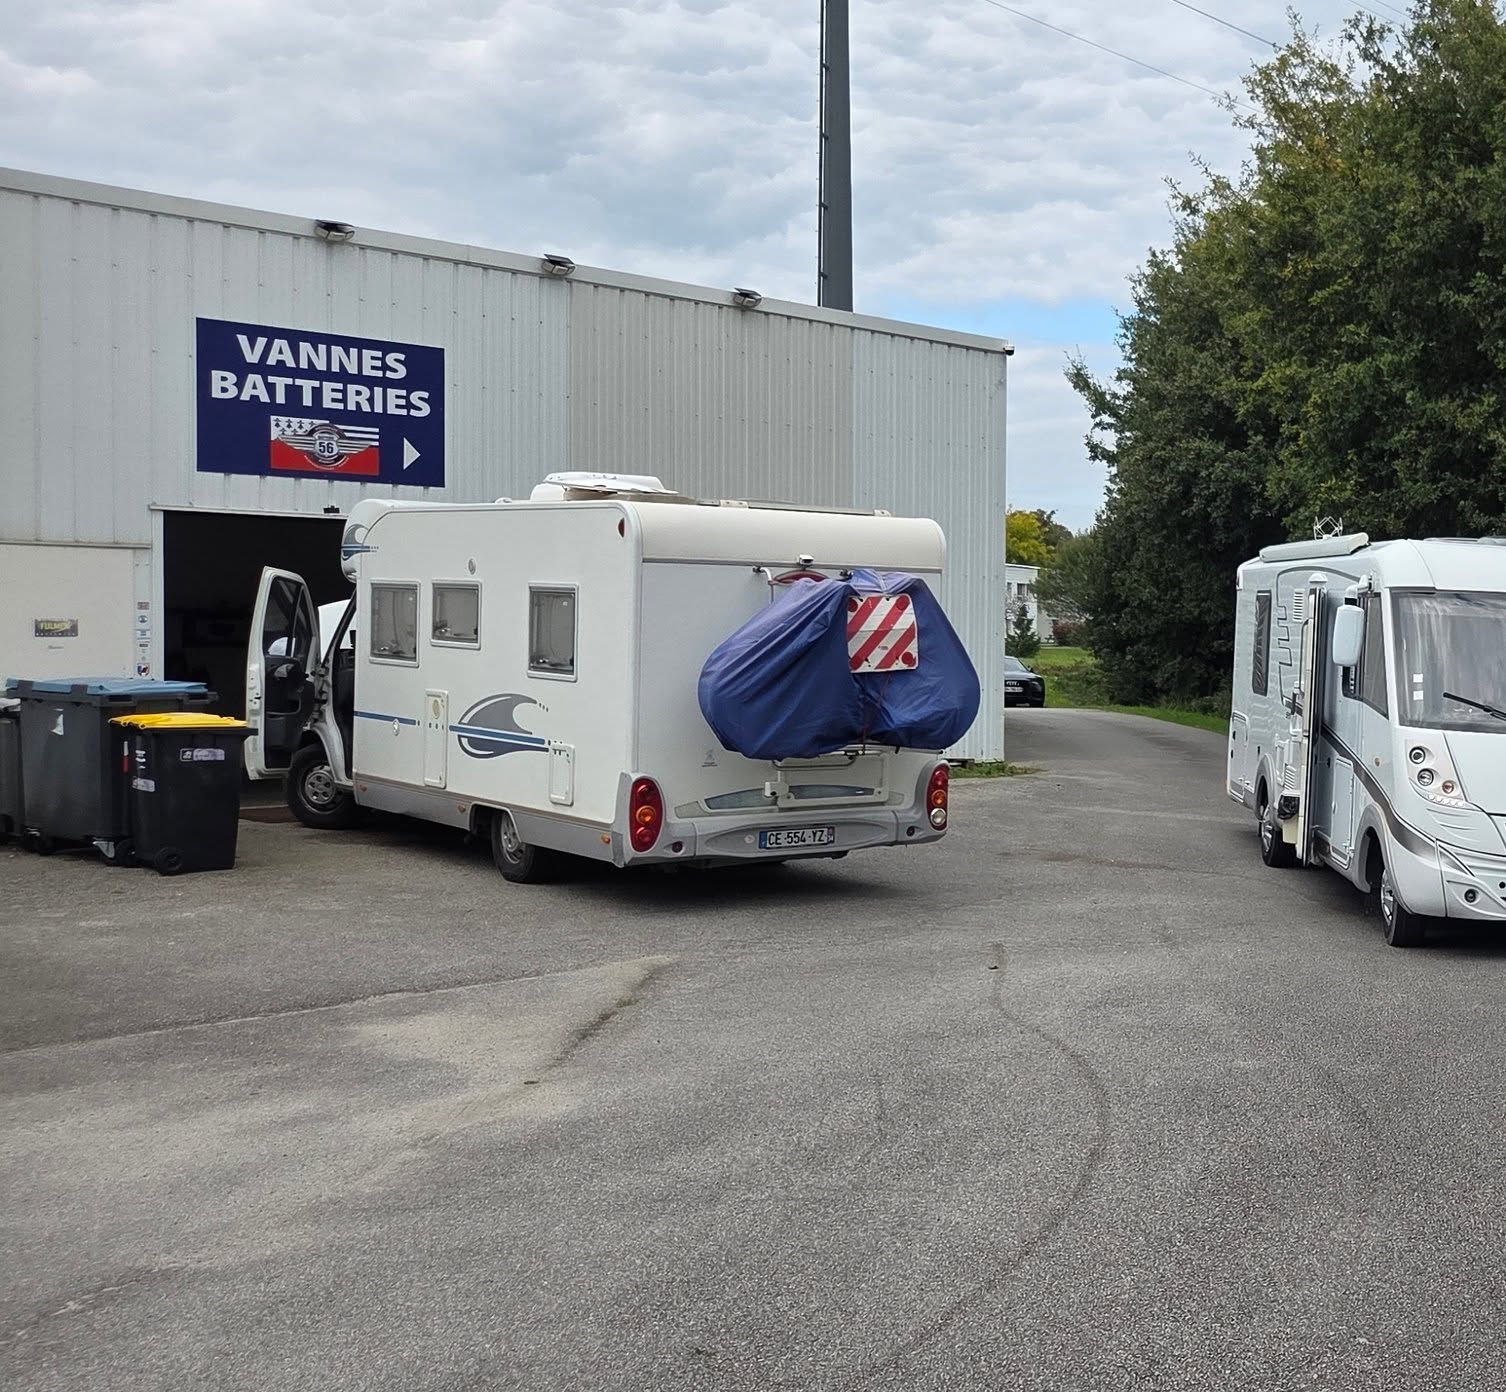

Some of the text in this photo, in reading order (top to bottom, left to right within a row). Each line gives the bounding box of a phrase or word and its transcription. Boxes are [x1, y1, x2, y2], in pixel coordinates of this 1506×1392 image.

[236, 334, 407, 380] VANNES
[211, 370, 431, 418] BATTERIES
[318, 441, 334, 454] 56
[768, 829, 825, 846] CE-554-YZ
